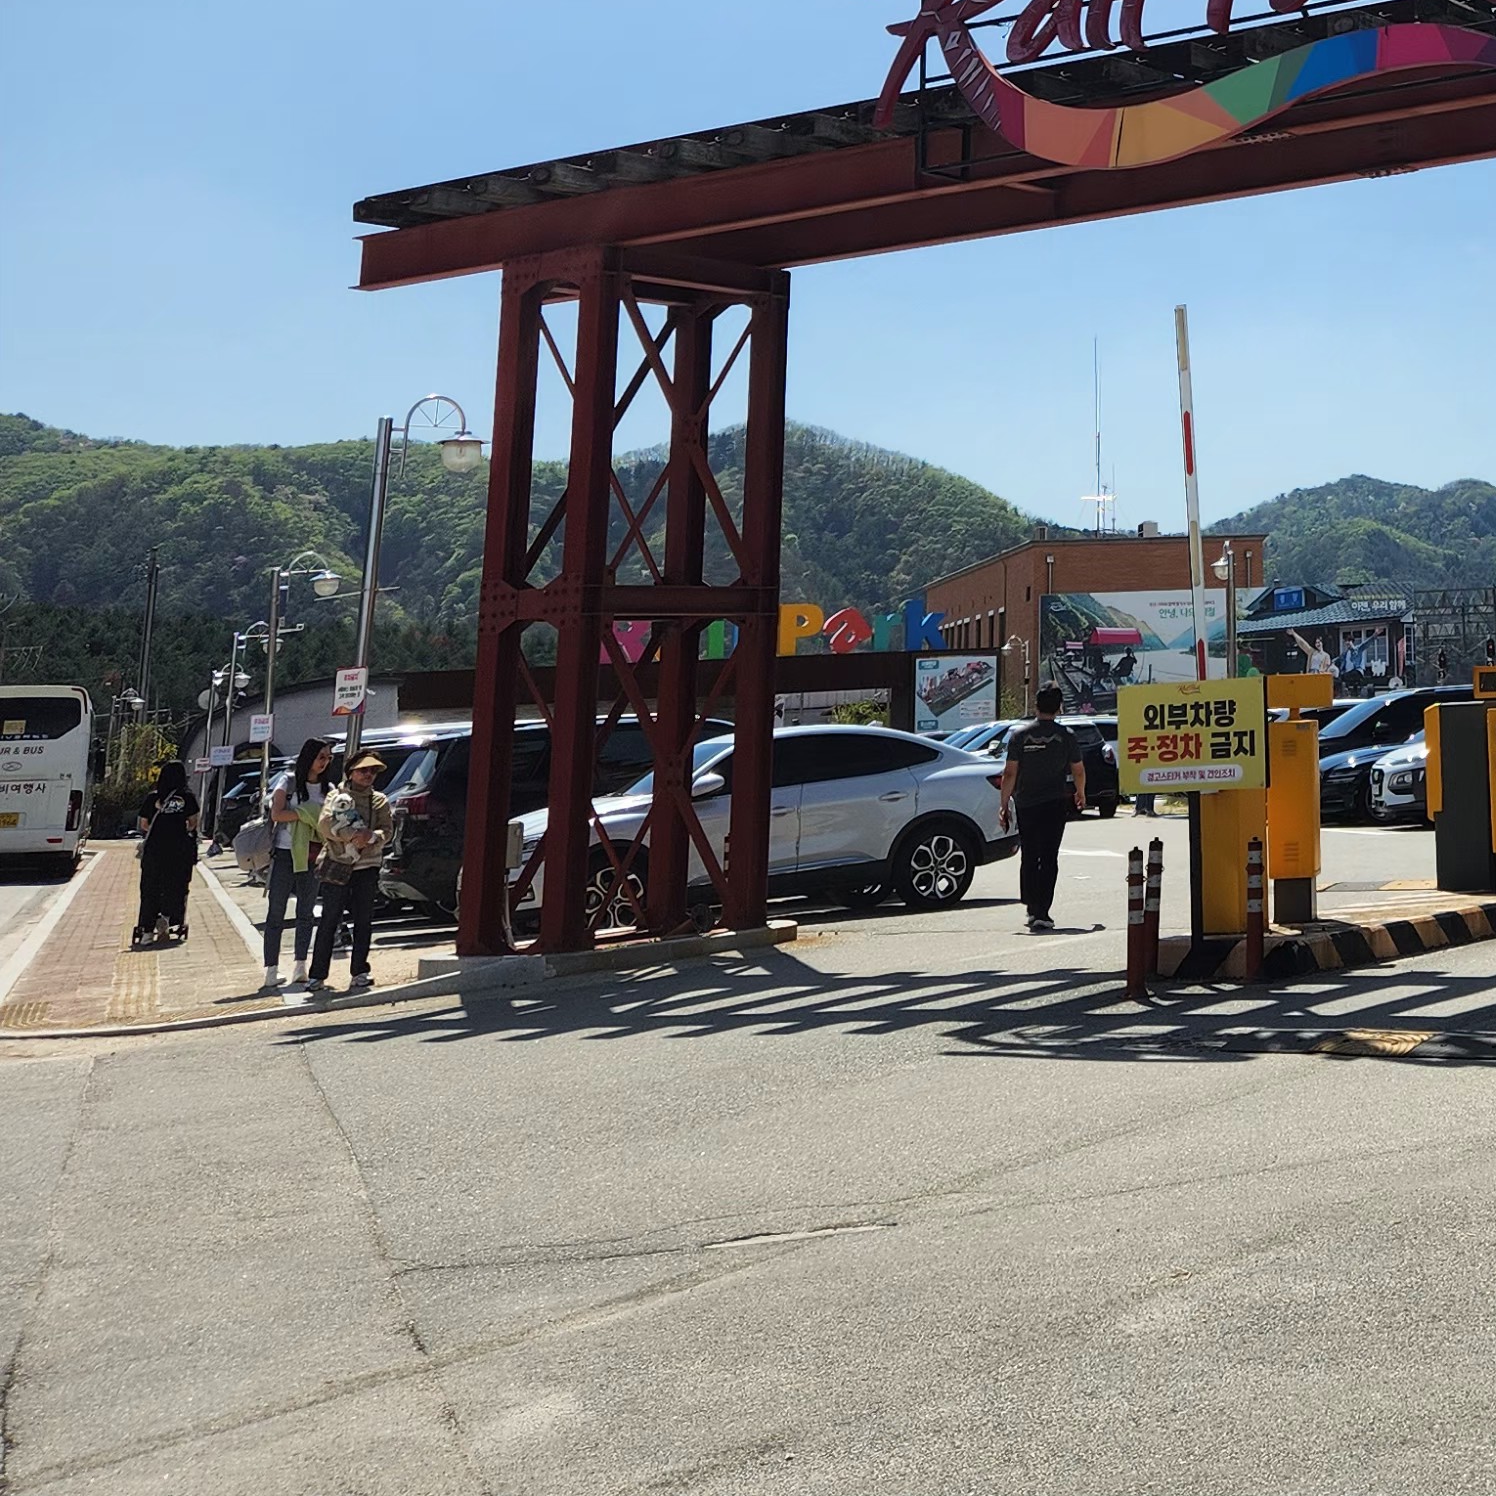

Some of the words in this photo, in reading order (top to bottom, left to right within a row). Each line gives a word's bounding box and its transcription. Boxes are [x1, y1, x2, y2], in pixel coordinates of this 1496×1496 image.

[776, 599, 949, 657] Park
[1143, 699, 1237, 731] 외부차량
[23, 745, 45, 755] BUS
[1127, 733, 1202, 764] 주·정차
[1209, 729, 1256, 760] 금지
[1207, 768, 1236, 779] 견인조치
